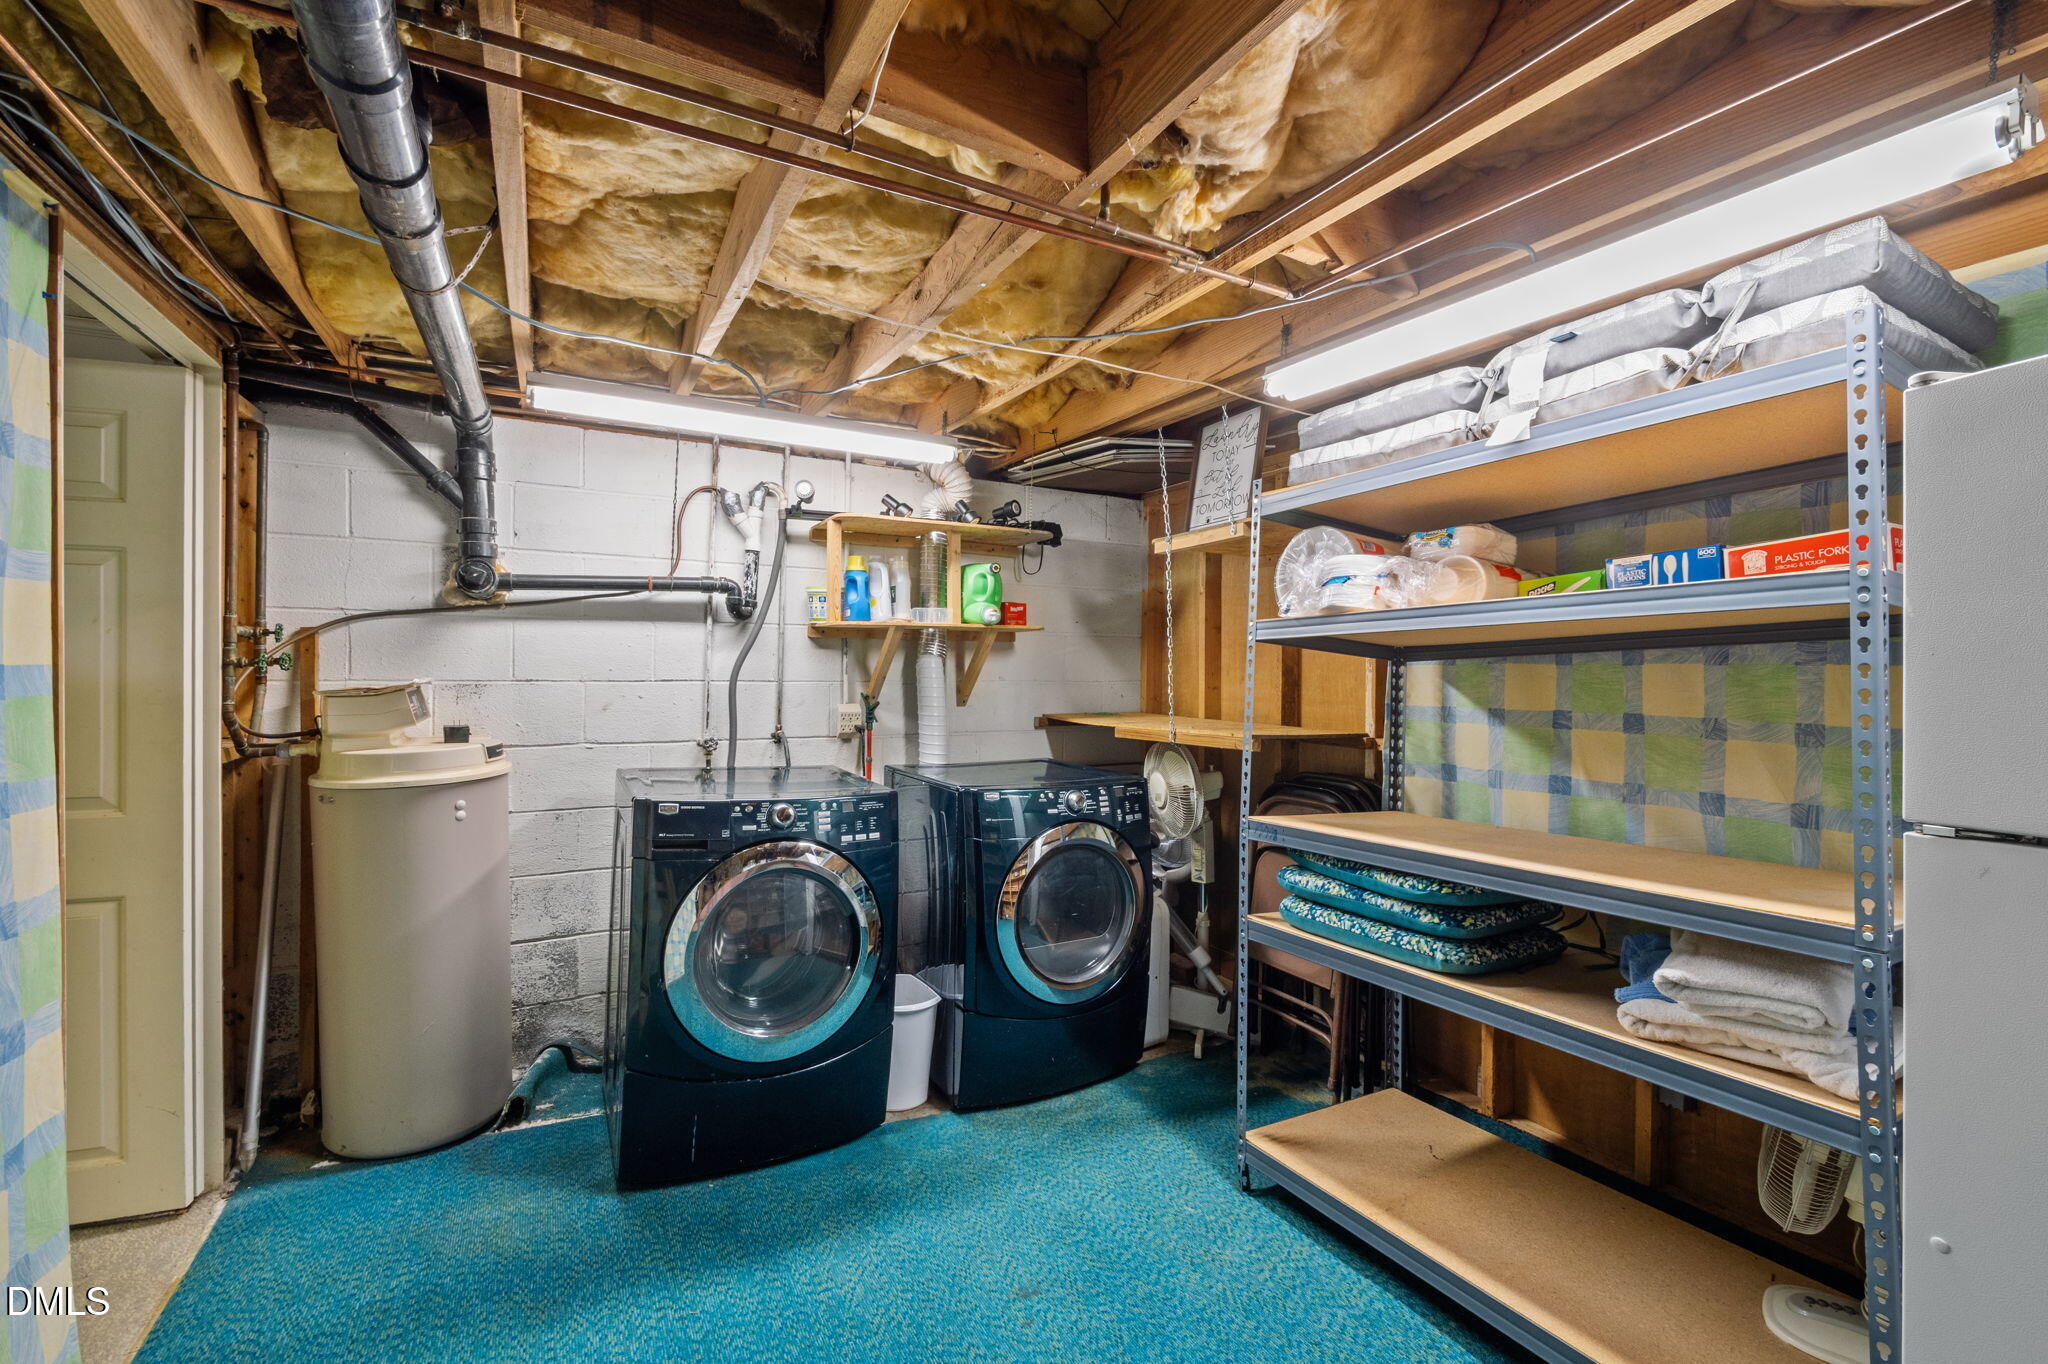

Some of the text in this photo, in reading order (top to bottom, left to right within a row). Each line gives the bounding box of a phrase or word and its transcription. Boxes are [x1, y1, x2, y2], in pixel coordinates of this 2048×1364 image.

[1774, 550, 1815, 564] PLASTIC
[1774, 562, 1798, 570] STRONG
[1805, 559, 1827, 567] TOUGH
[1616, 568, 1647, 578] PLASTIC
[1617, 574, 1646, 583] SPOONS
